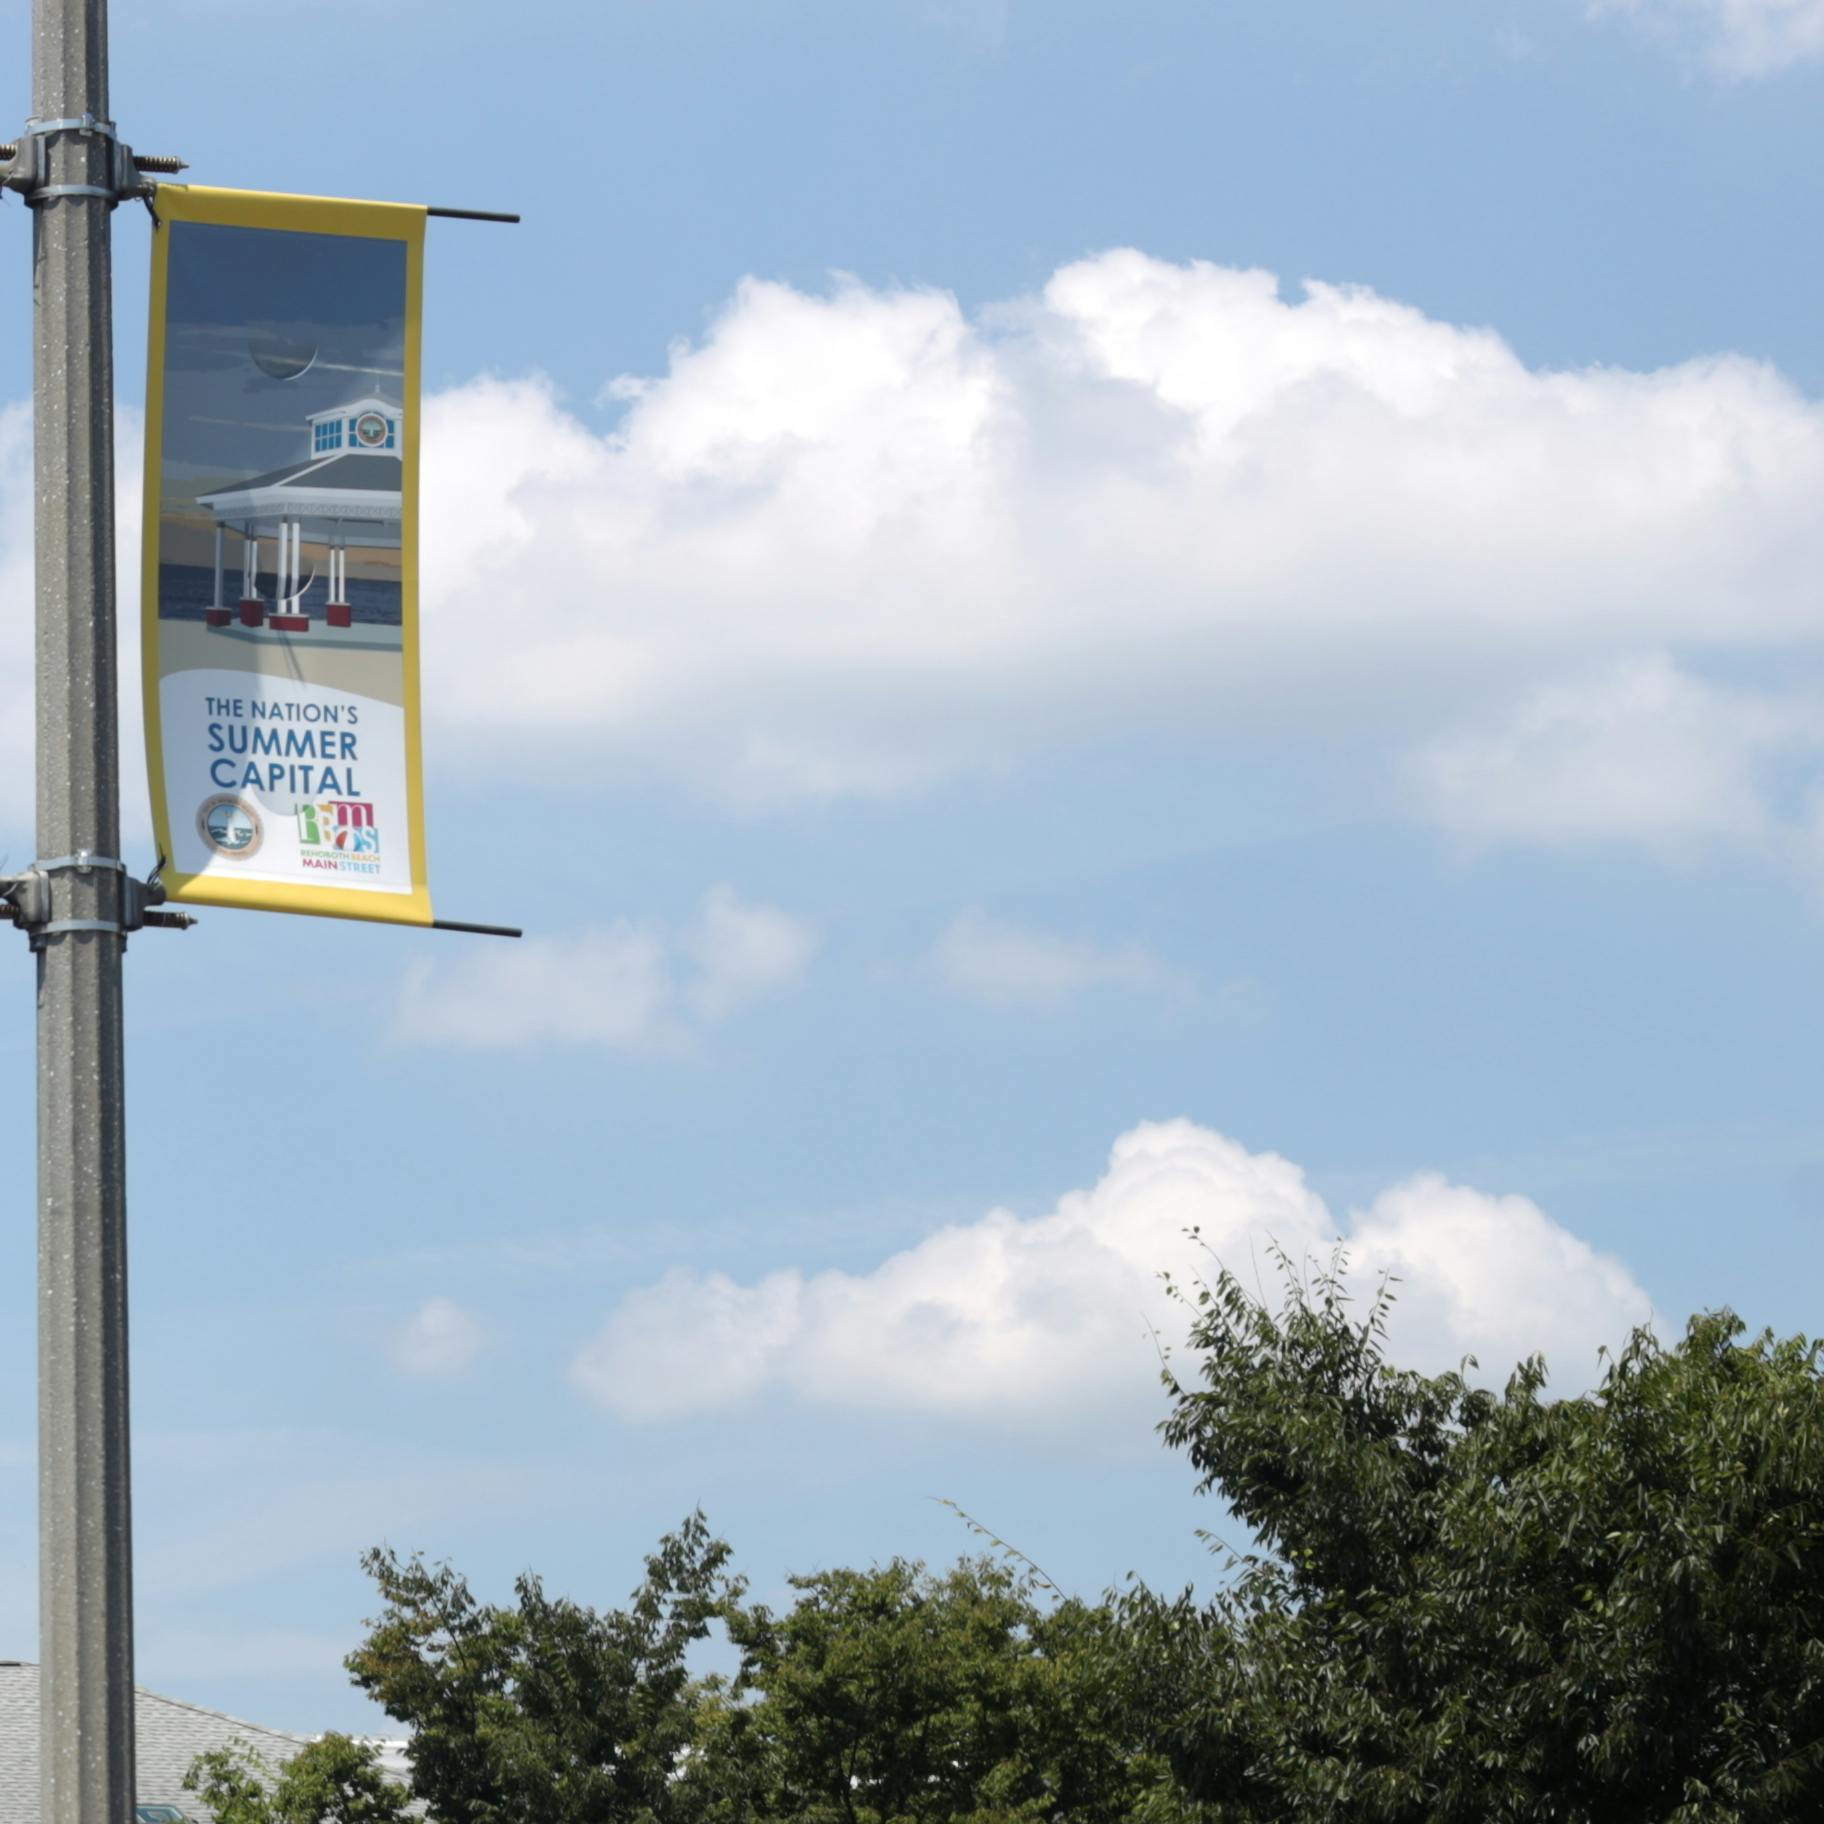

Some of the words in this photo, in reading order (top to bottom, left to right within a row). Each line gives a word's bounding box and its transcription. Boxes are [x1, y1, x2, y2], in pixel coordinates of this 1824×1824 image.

[205, 697, 244, 718] THE
[251, 700, 358, 725] NATION'S
[207, 722, 358, 761] SUMMER
[210, 758, 361, 796] CAPITAL
[303, 859, 339, 871] MAIN
[339, 862, 381, 875] STREET
